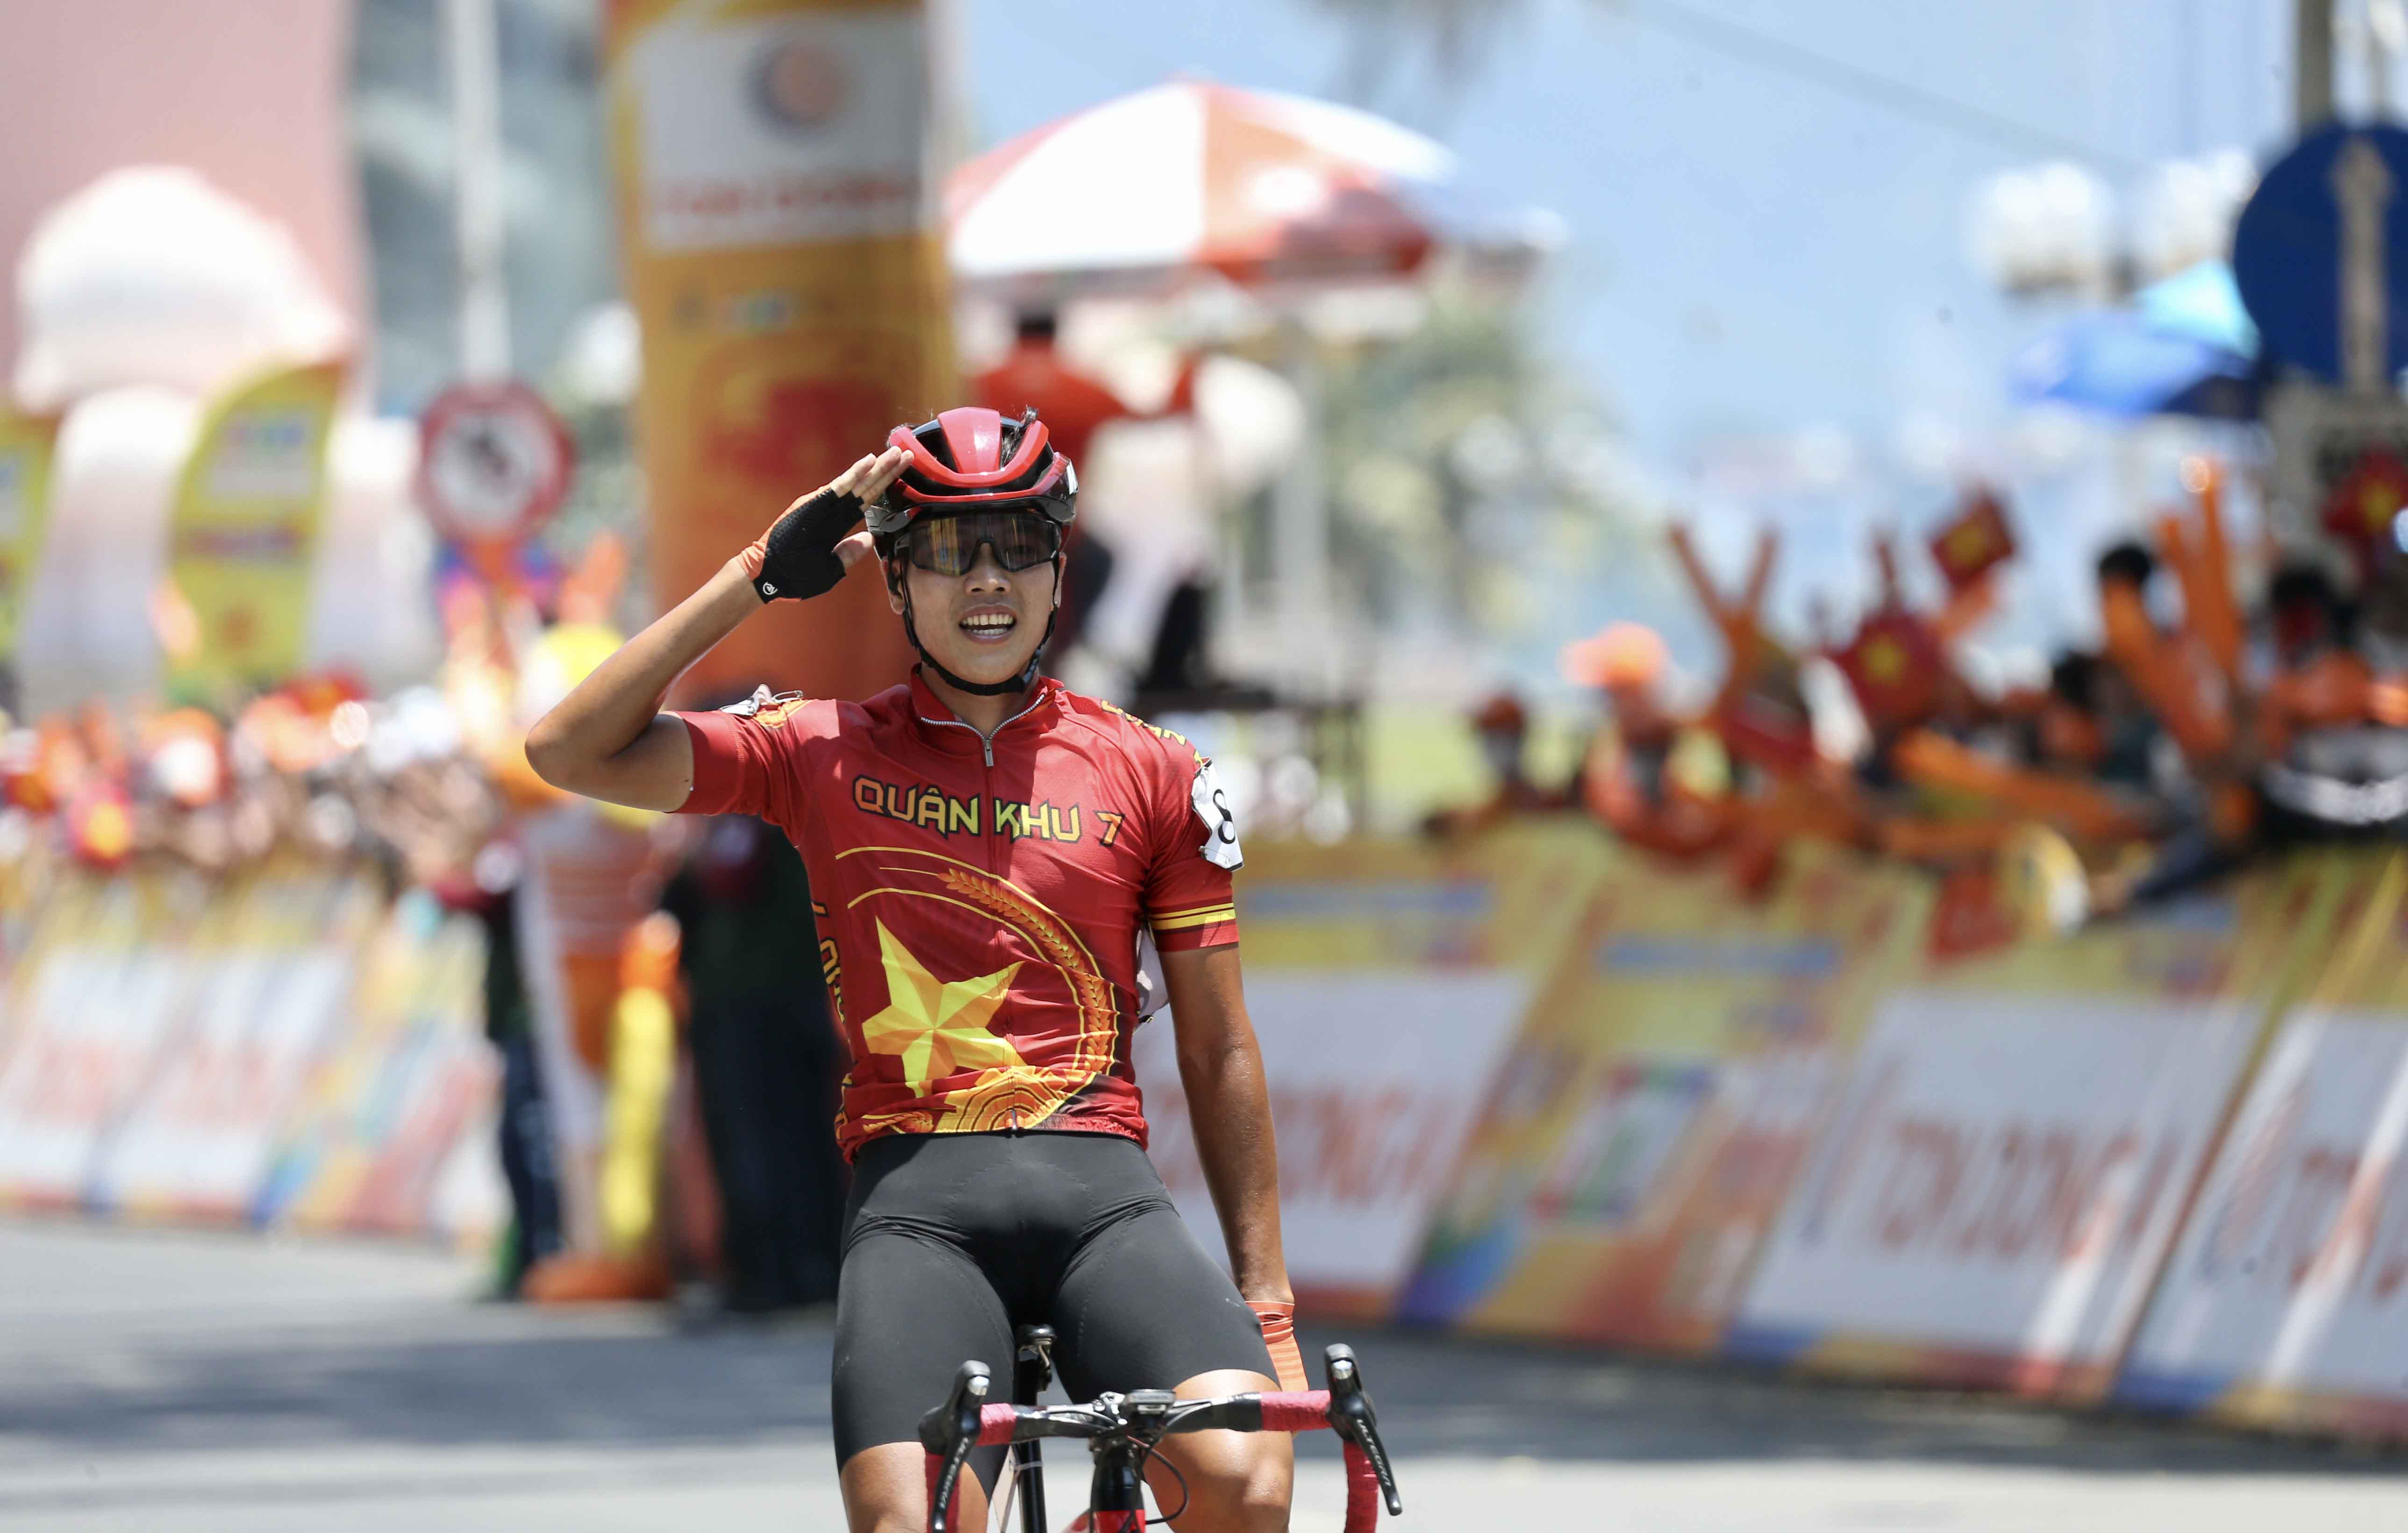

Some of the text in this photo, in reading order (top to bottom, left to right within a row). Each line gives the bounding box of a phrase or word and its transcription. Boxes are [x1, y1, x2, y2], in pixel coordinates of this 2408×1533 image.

[852, 774, 1125, 847] QUÂN KHU 7
